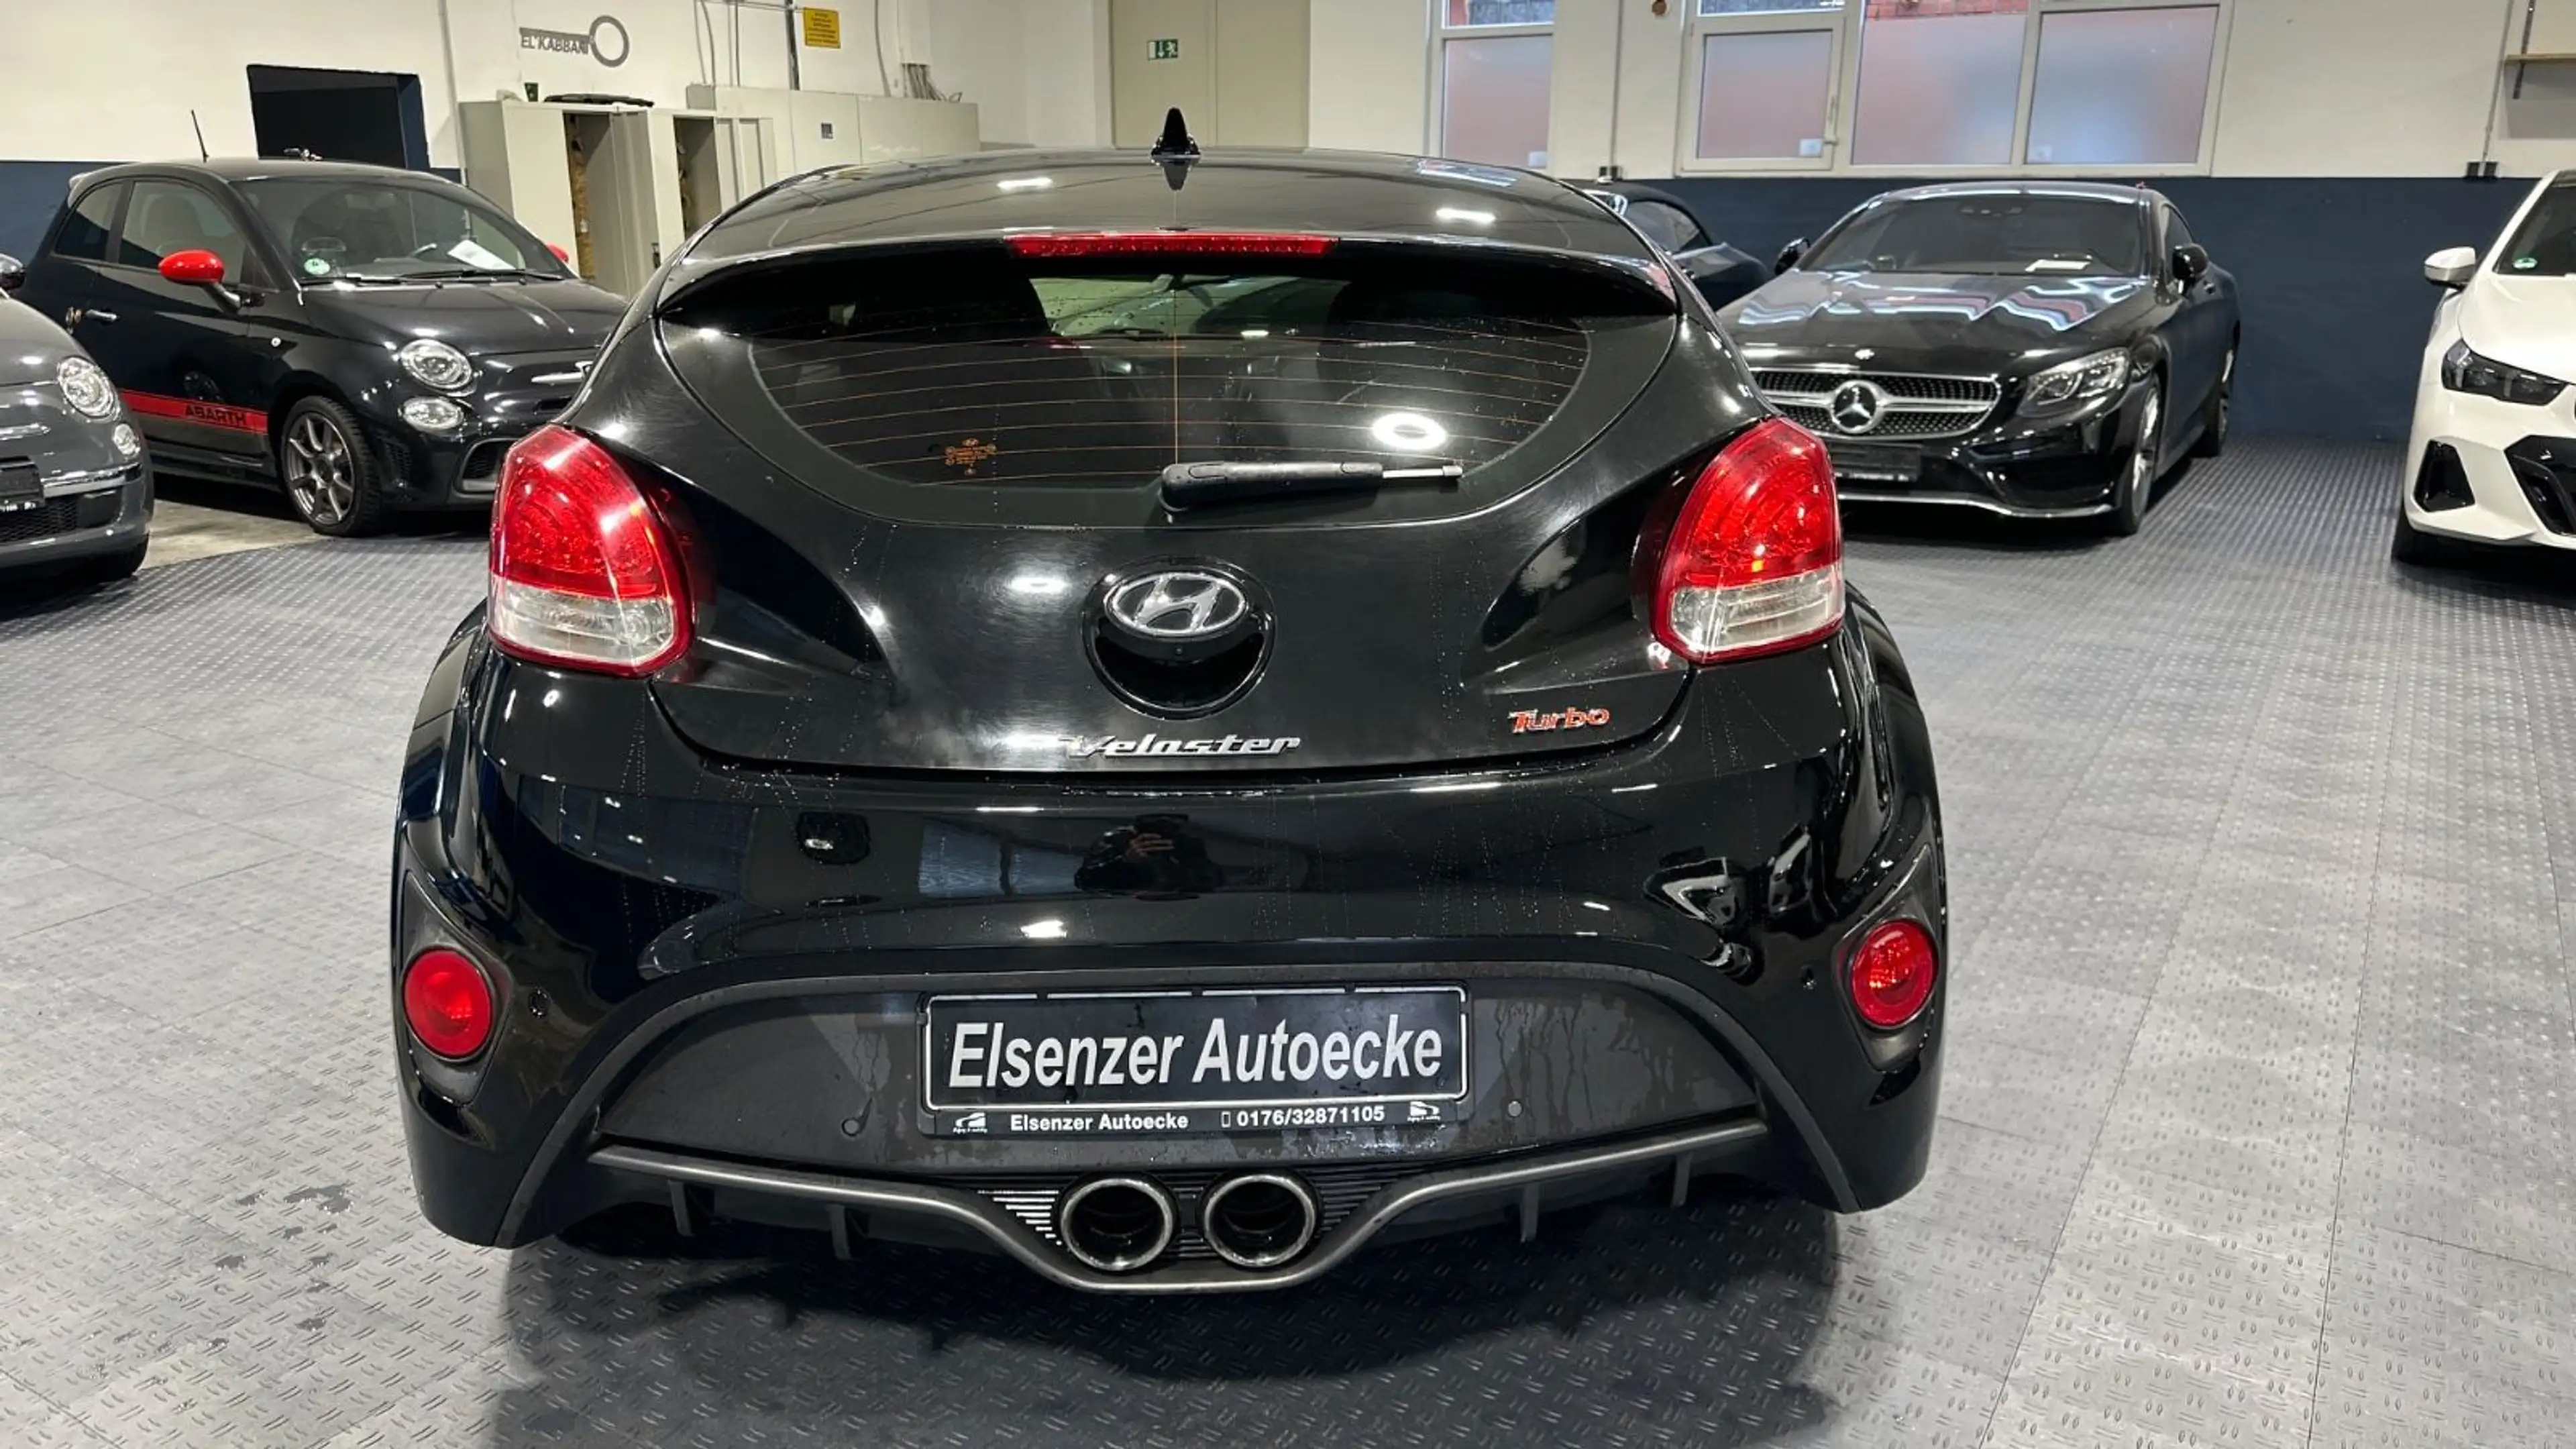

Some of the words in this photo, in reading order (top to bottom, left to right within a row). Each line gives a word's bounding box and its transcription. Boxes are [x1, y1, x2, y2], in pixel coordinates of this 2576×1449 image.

[186, 403, 247, 426] ABARTH
[1507, 707, 1610, 734] Turbo
[1069, 733, 1301, 759] Veloster
[949, 1022, 1184, 1087] Elsenzer
[1191, 1014, 1442, 1082] Autoecke
[1010, 1114, 1093, 1132] Elsenzer
[1098, 1112, 1189, 1130] Autoecke
[1236, 1105, 1385, 1127] 0176/32871105
